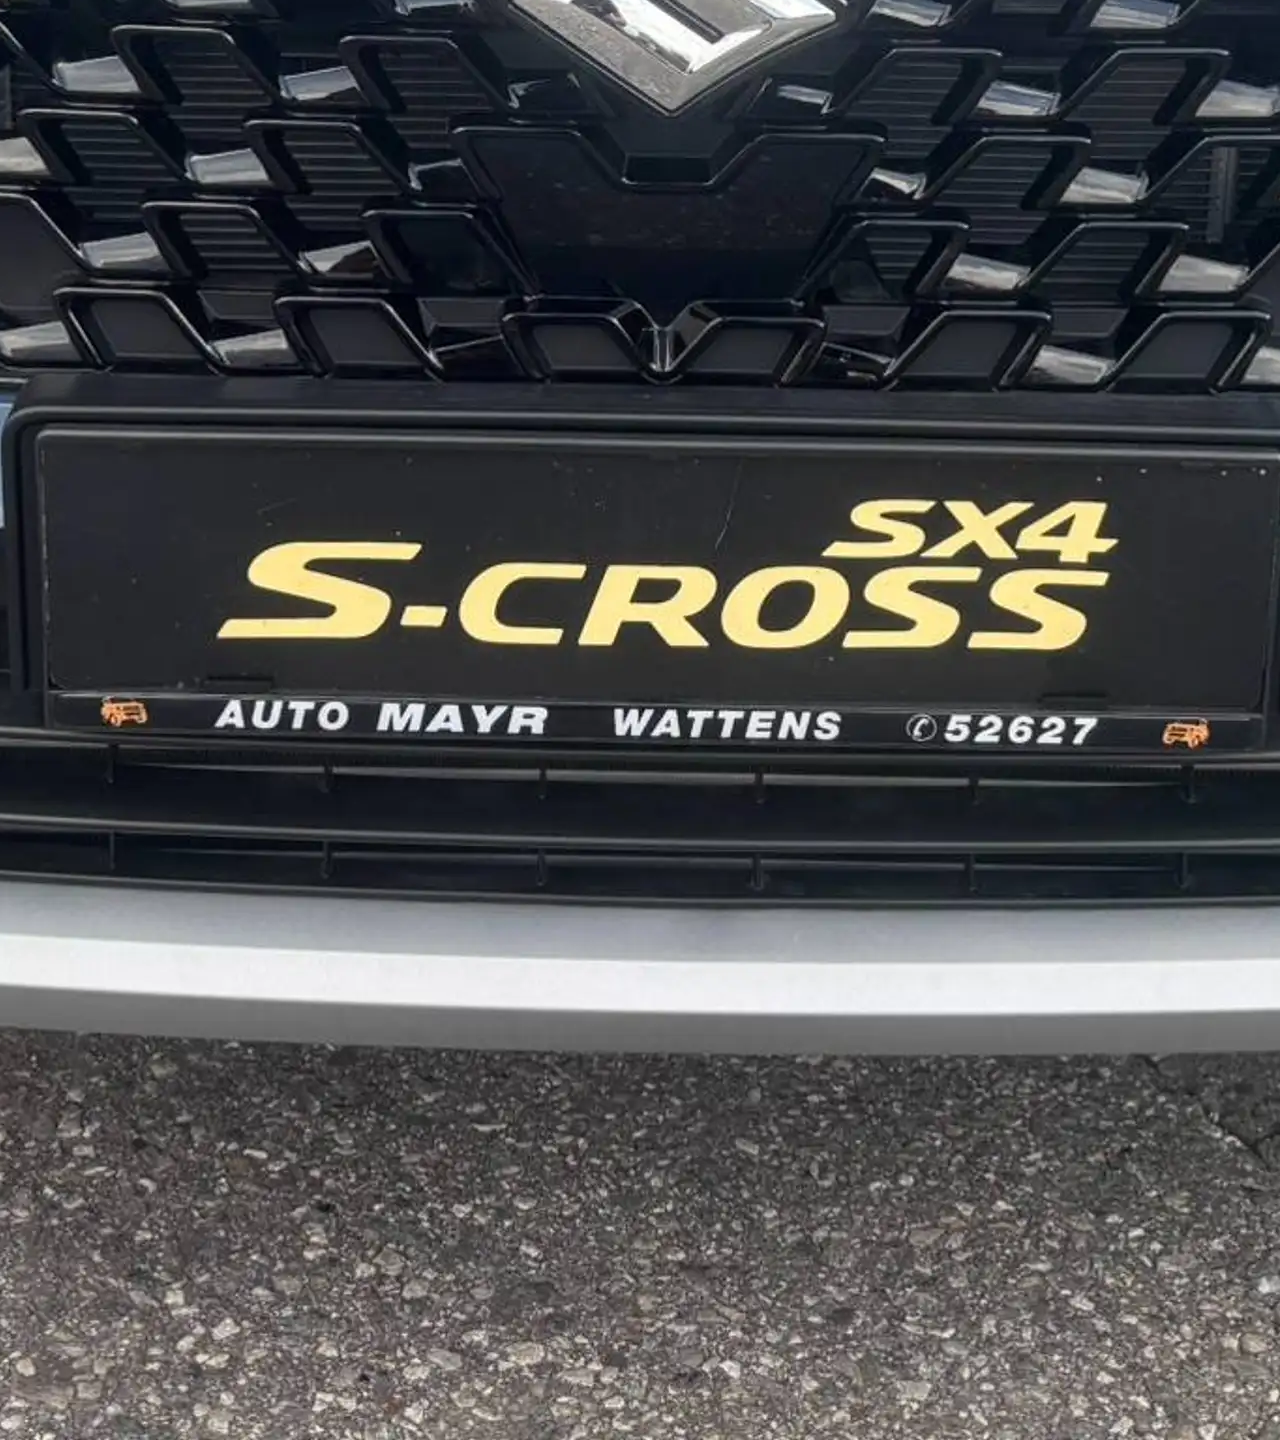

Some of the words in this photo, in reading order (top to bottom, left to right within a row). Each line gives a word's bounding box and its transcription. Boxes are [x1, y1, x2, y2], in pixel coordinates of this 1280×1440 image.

[824, 499, 1119, 564] SX4
[216, 540, 1111, 652] S-CROSS
[213, 698, 350, 732] AUTO
[375, 702, 549, 736] MAYR
[612, 708, 843, 742] WATTENS
[943, 713, 1099, 746] 52627
